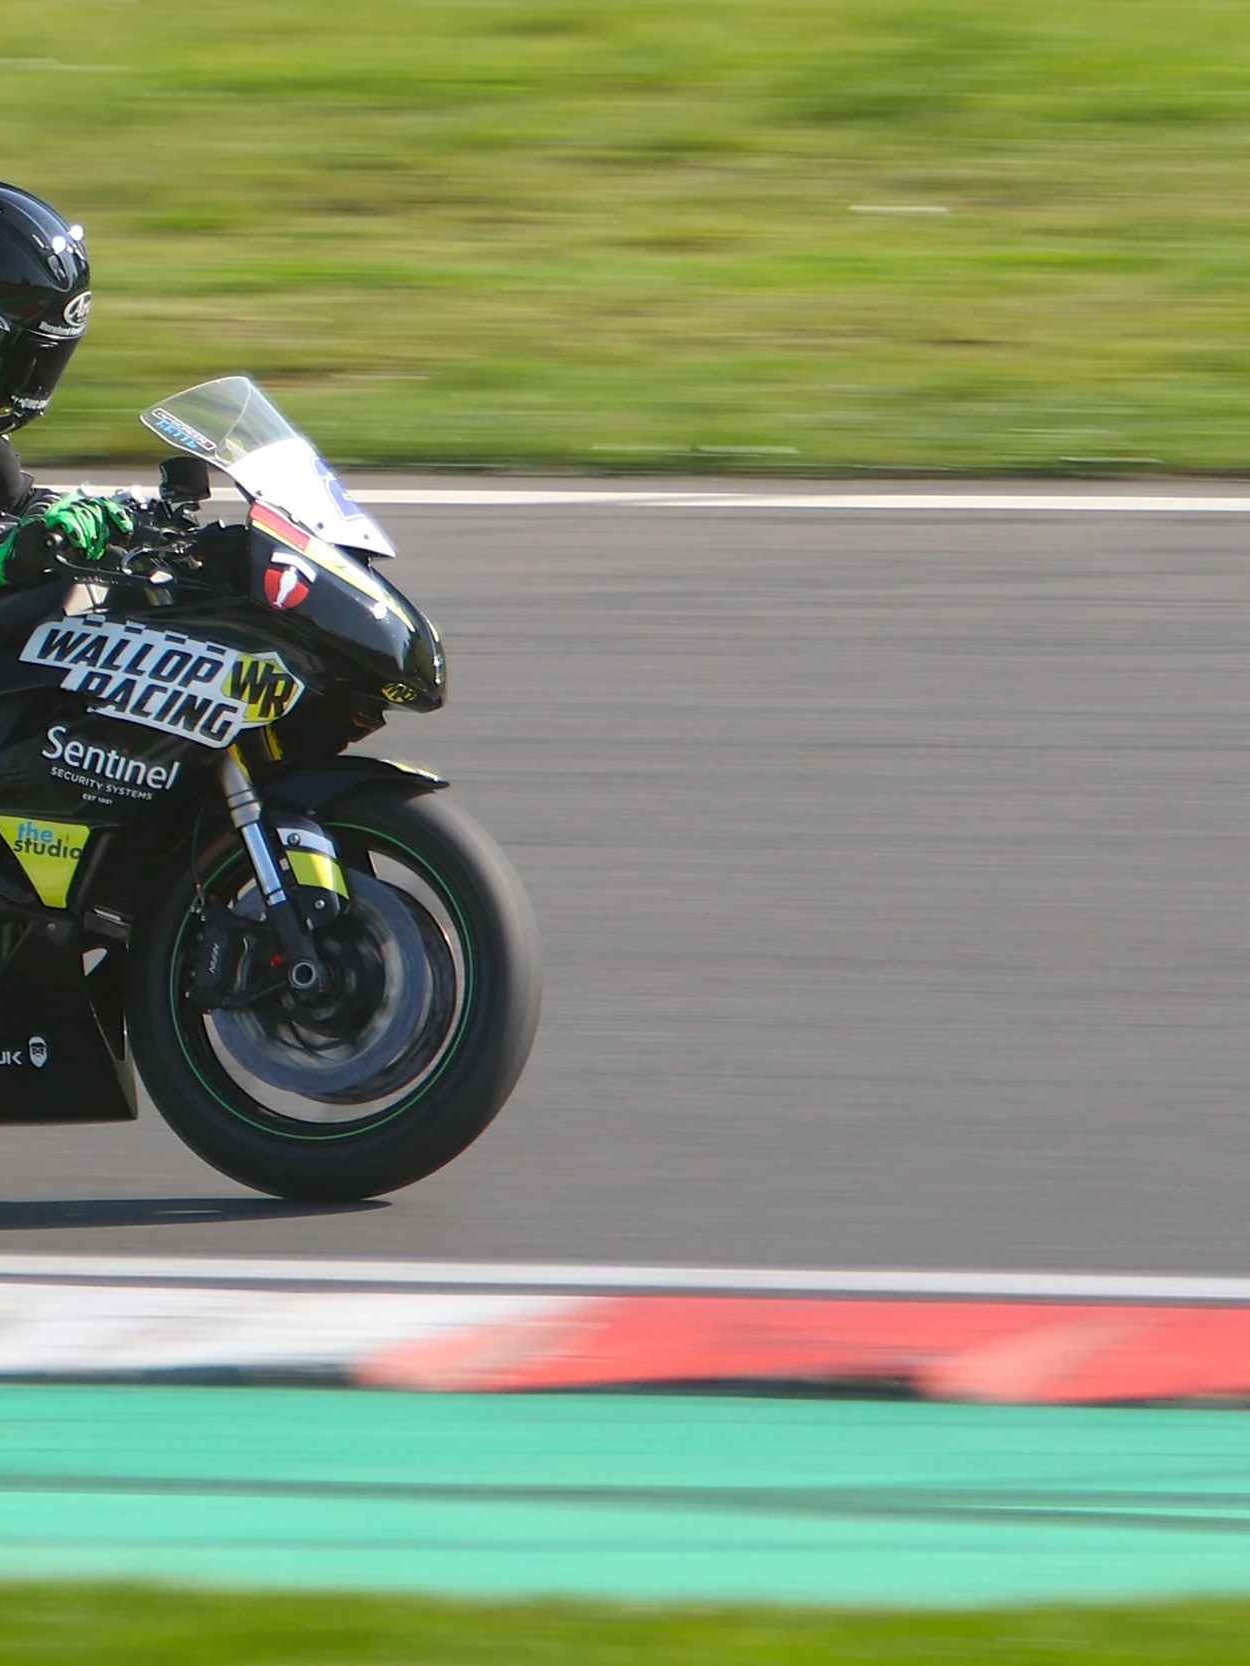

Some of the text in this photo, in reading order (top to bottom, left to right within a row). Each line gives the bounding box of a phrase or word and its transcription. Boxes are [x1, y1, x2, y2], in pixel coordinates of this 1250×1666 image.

[36, 628, 225, 689] WALLOP
[77, 670, 240, 742] RACING
[228, 659, 298, 719] WR
[41, 725, 181, 790] Sentinel
[50, 766, 153, 801] SECURITY SYSTEMS
[13, 838, 83, 860] studio
[17, 821, 54, 843] the
